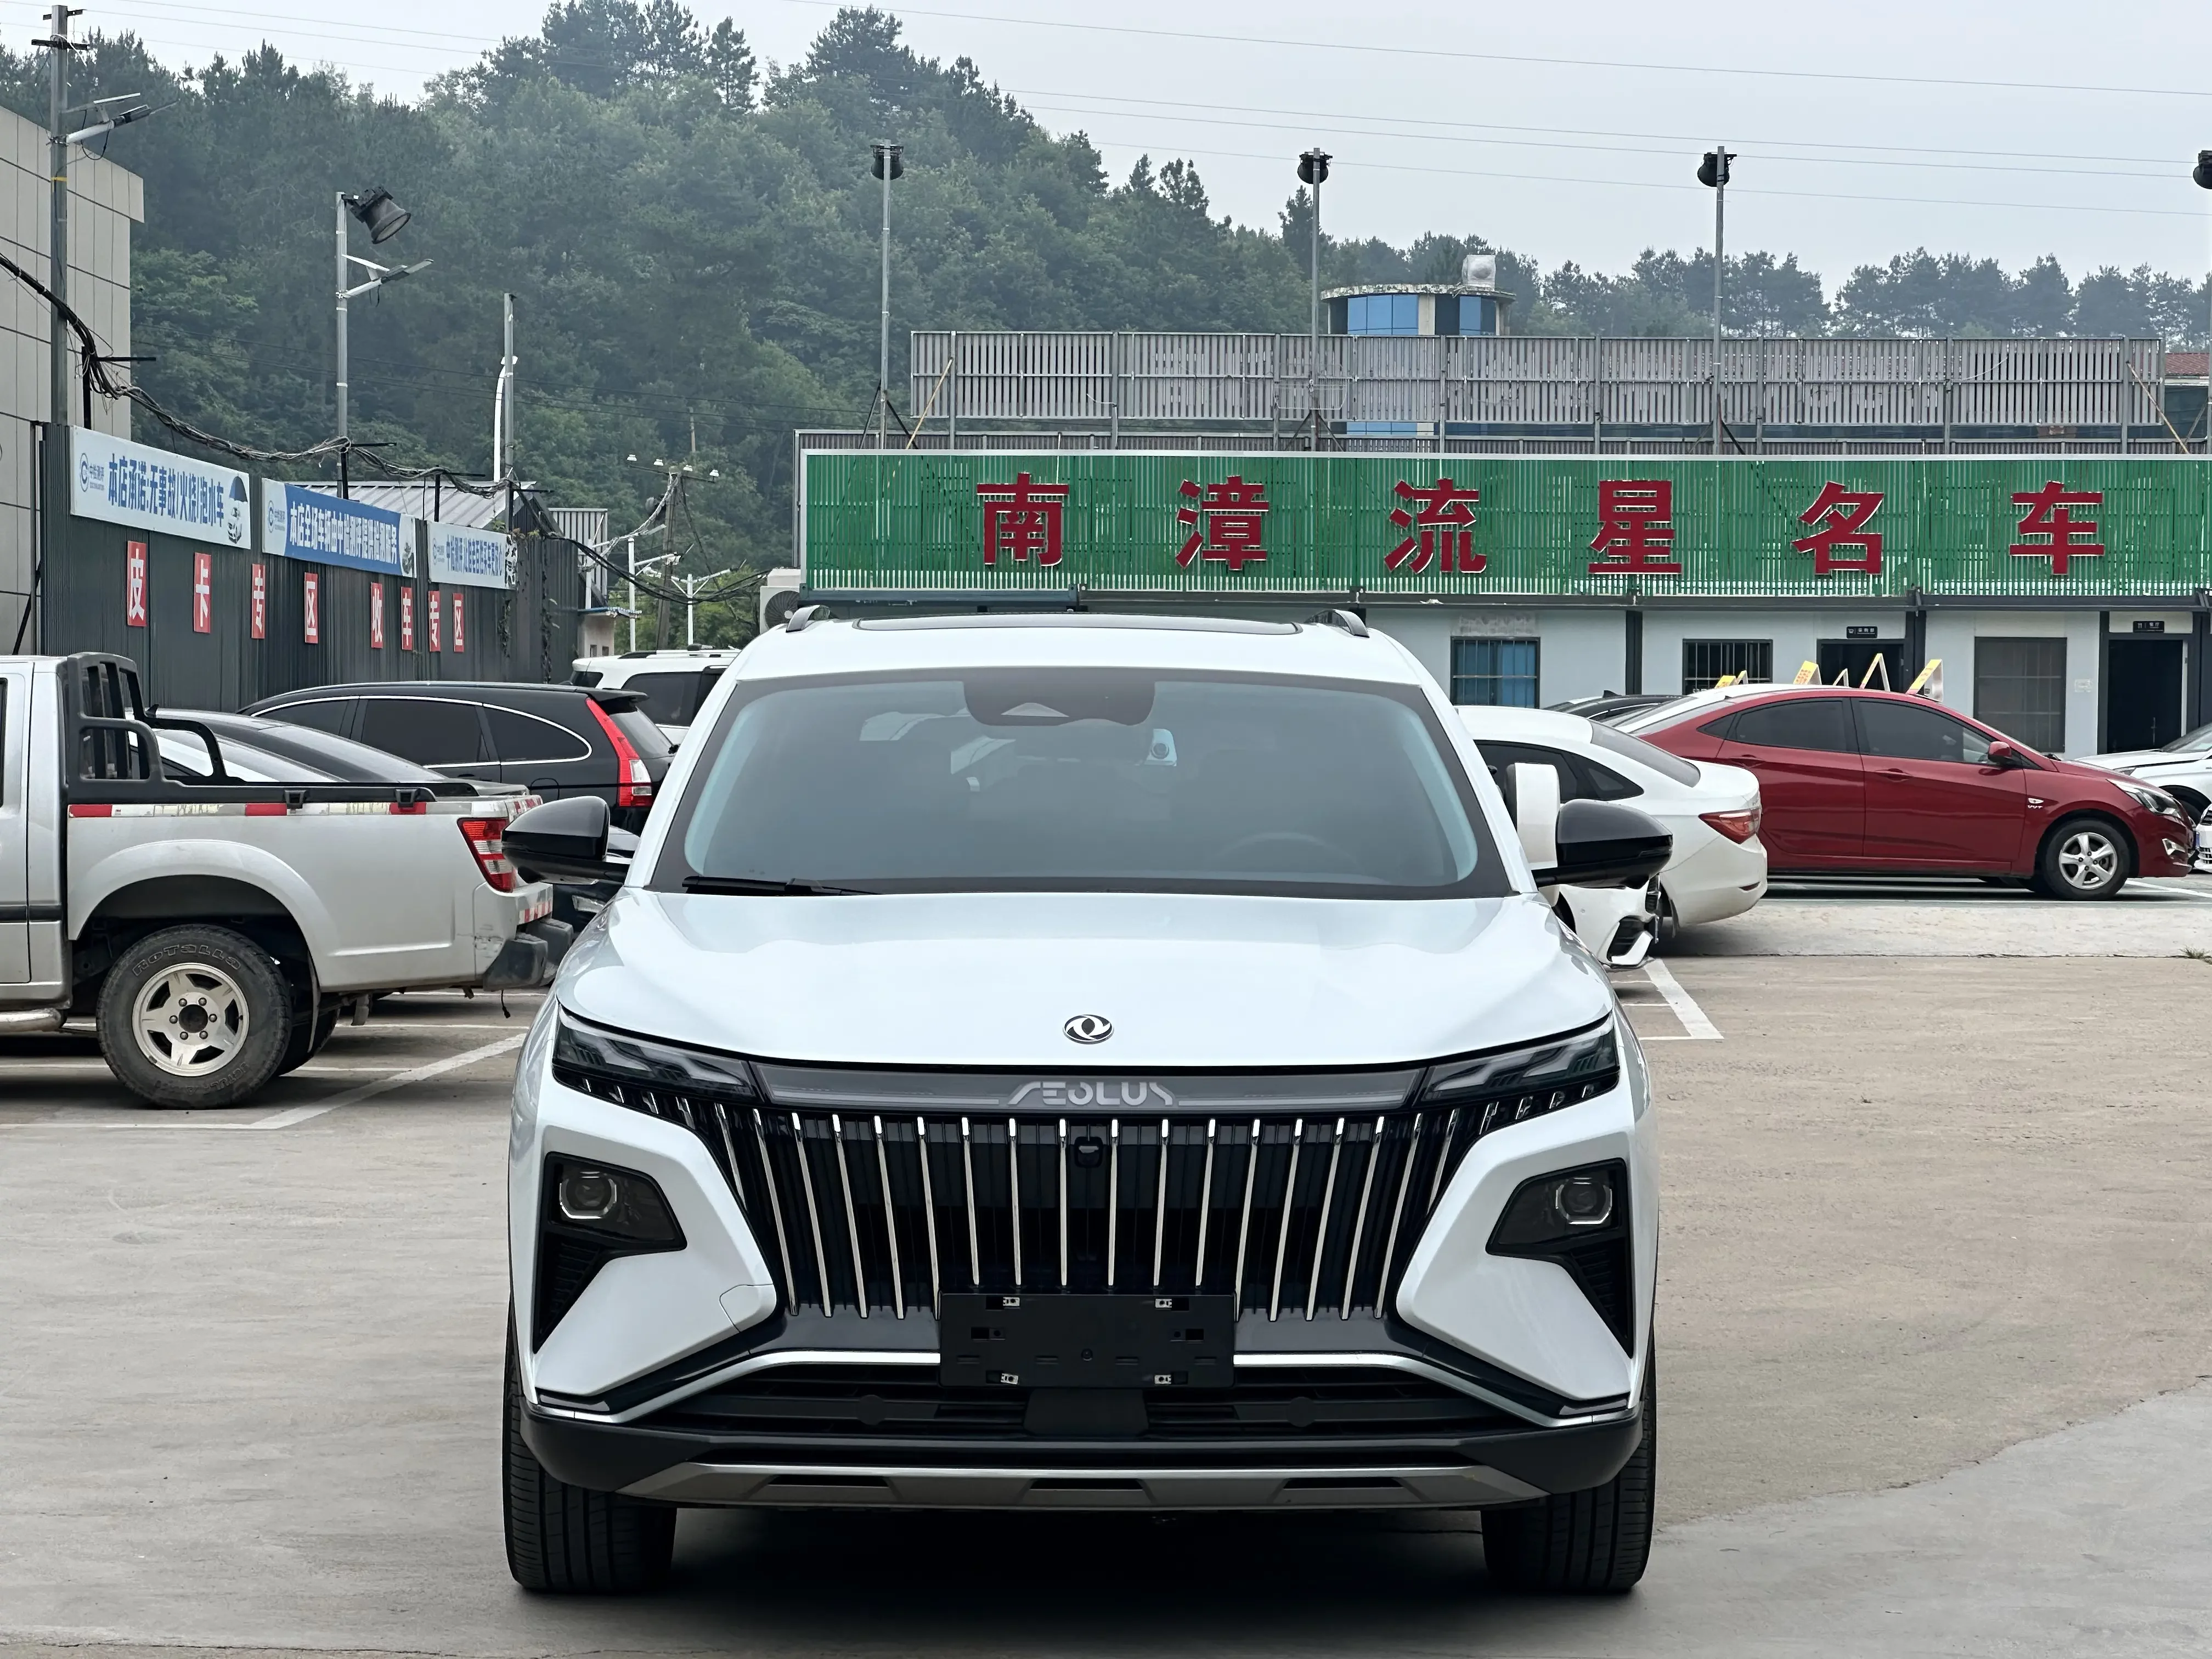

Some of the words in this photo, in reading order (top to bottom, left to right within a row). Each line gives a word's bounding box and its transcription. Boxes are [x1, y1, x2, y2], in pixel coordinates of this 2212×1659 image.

[977, 472, 2105, 575] 南漳流星名车
[129, 548, 317, 636] 皮卡专区
[373, 588, 463, 647] 收车专区
[1008, 1081, 1173, 1106] AEOLUS
